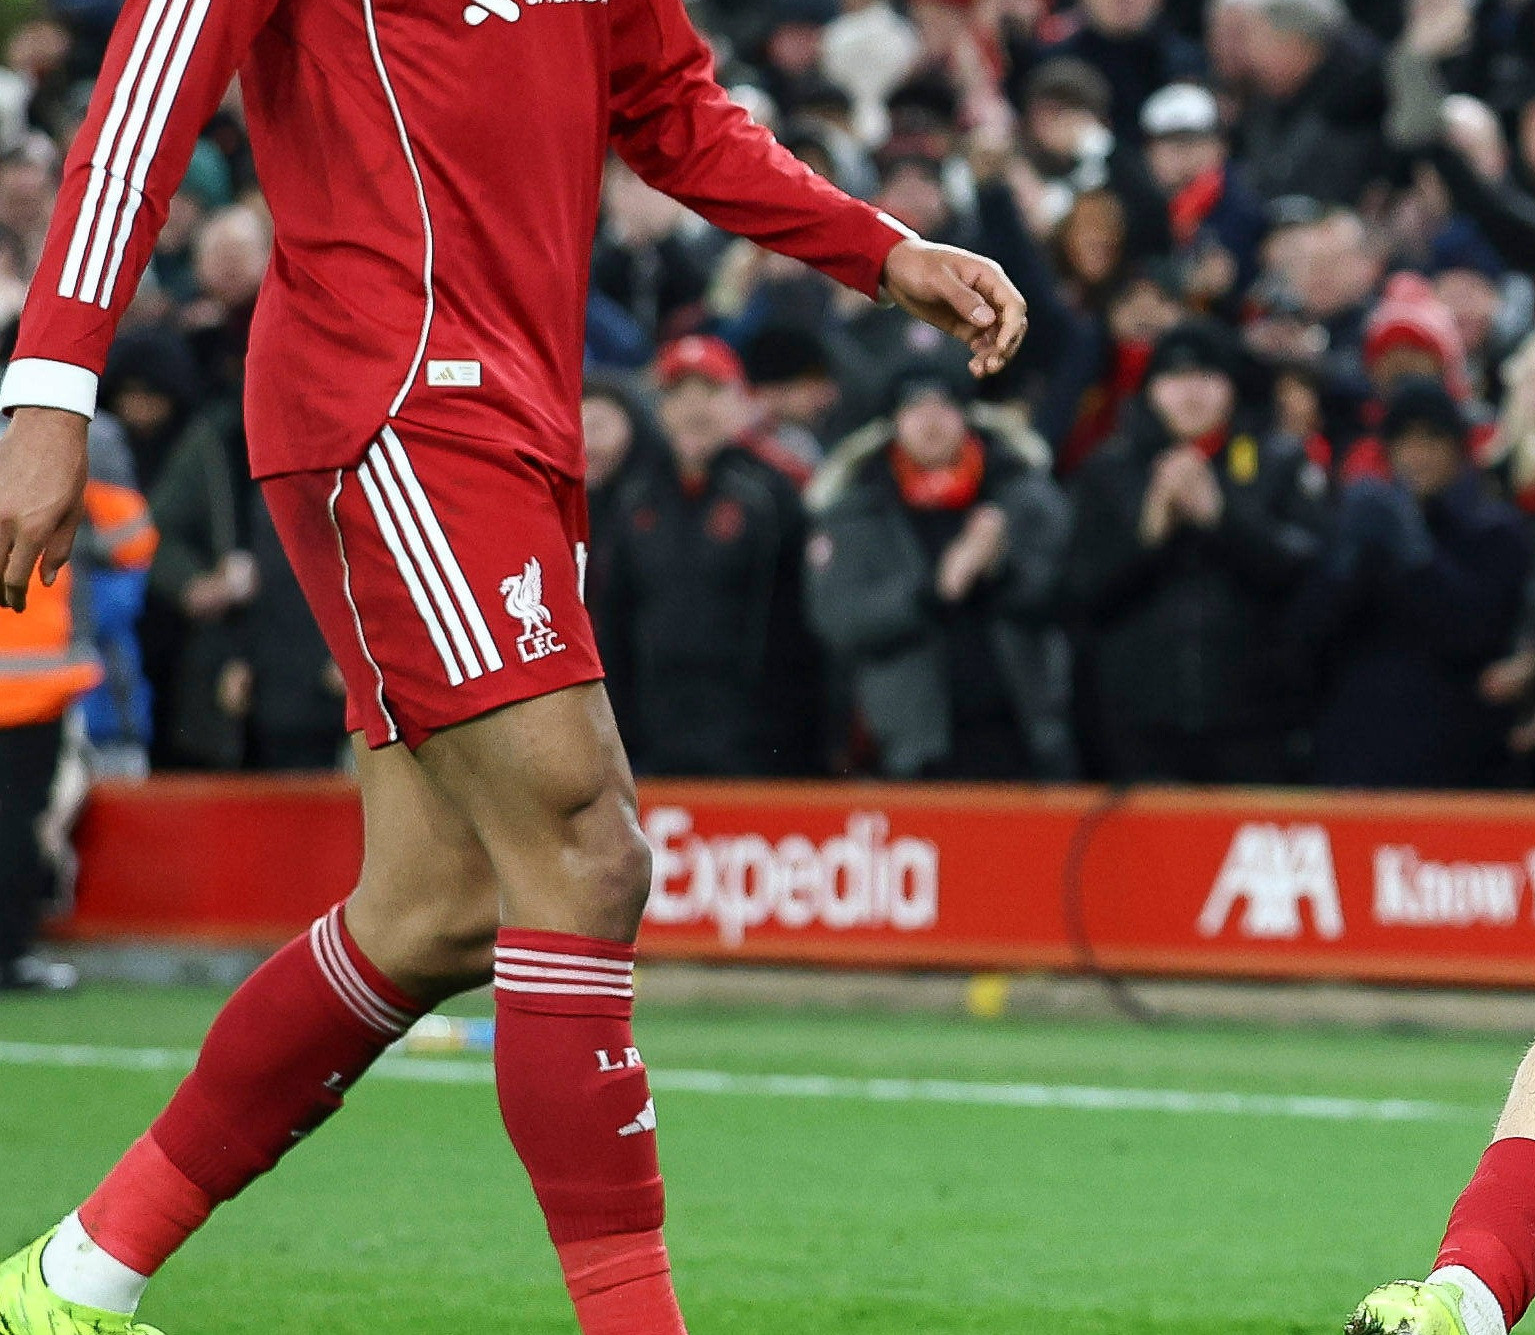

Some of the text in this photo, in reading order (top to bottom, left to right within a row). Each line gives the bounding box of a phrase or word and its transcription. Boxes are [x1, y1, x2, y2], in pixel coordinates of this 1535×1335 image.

[644, 807, 940, 948] Expedia
[1197, 823, 1345, 939] AXA
[1374, 844, 1525, 928] Know
